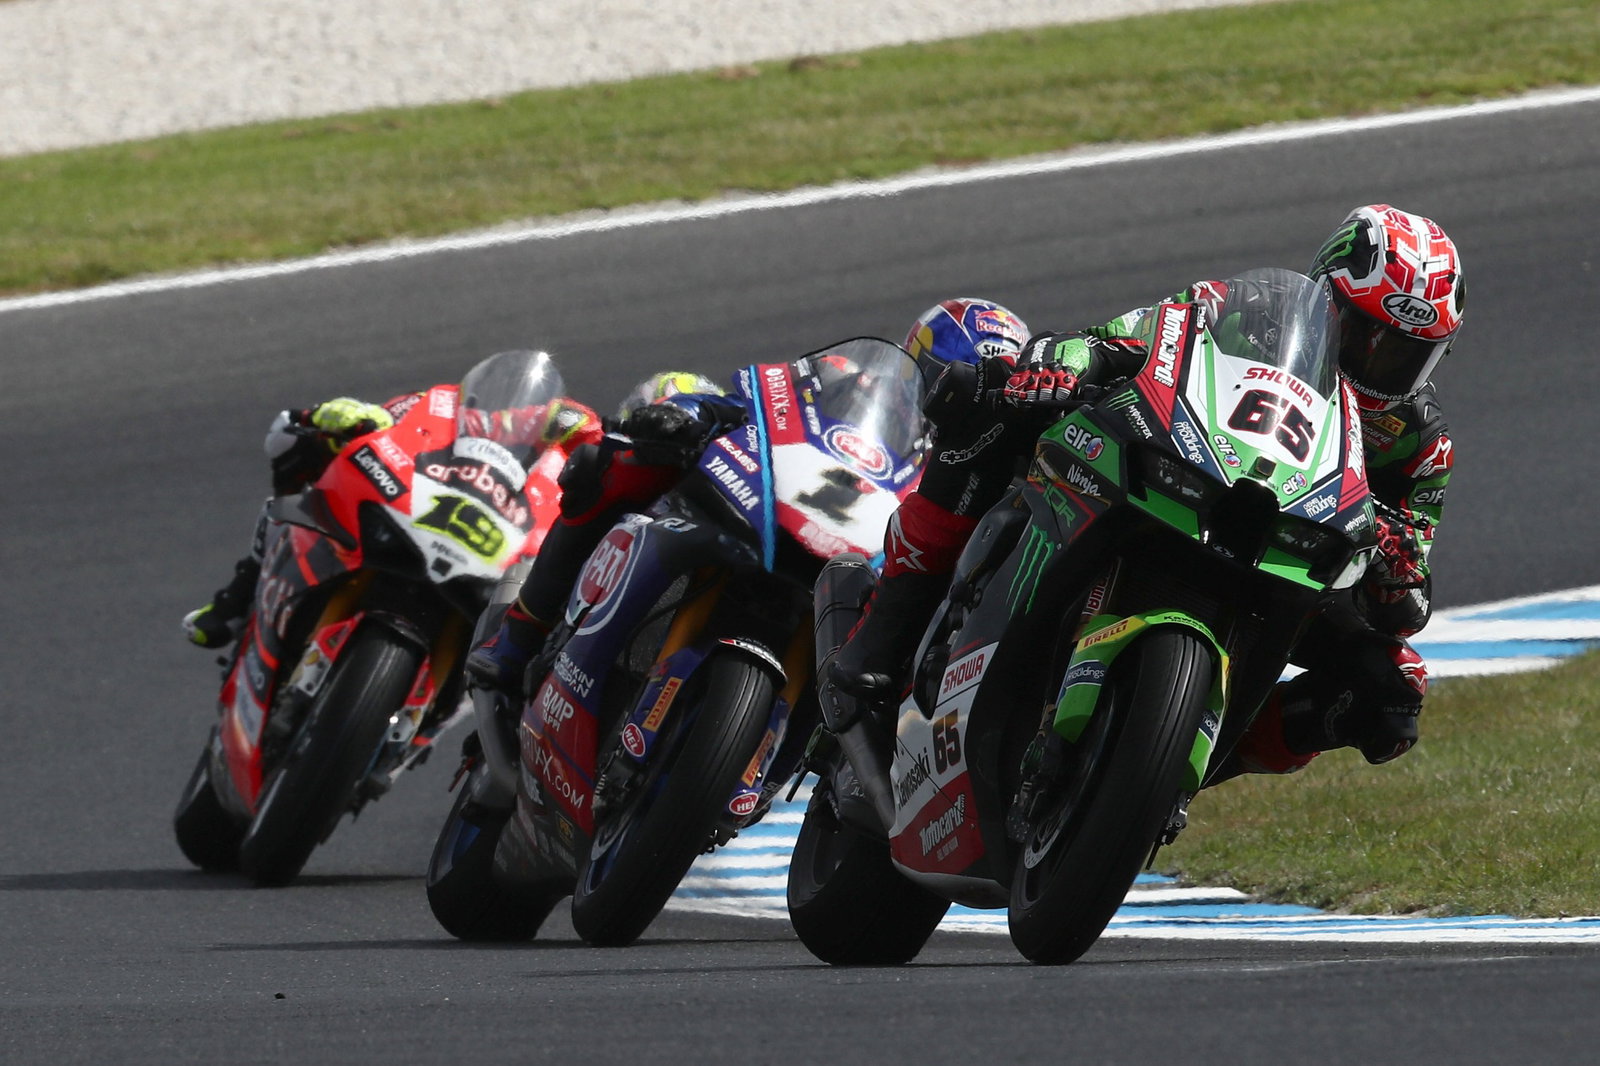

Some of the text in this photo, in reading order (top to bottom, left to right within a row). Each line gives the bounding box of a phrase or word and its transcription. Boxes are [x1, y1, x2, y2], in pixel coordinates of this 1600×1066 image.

[1386, 295, 1434, 321] Arai
[975, 319, 1005, 336] Red
[1242, 367, 1313, 408] SHOWA
[1063, 422, 1093, 452] elf
[1128, 404, 1153, 440] MONSTER
[1227, 388, 1316, 464] 65
[939, 422, 1005, 465] alpinestars
[1213, 434, 1236, 456] elf
[354, 446, 399, 496] Lenovo
[705, 456, 761, 511] YAMAHA
[1066, 463, 1102, 497] Ninja
[1282, 475, 1302, 497] elf
[1413, 487, 1445, 505] elf
[411, 494, 507, 560] 19
[585, 540, 627, 593] PATA
[1084, 619, 1129, 648] PIRELLI
[942, 653, 985, 695] SHOWA
[542, 683, 575, 722] BMP
[624, 728, 638, 751] HEL
[932, 708, 962, 776] 65
[736, 801, 757, 812] HEL
